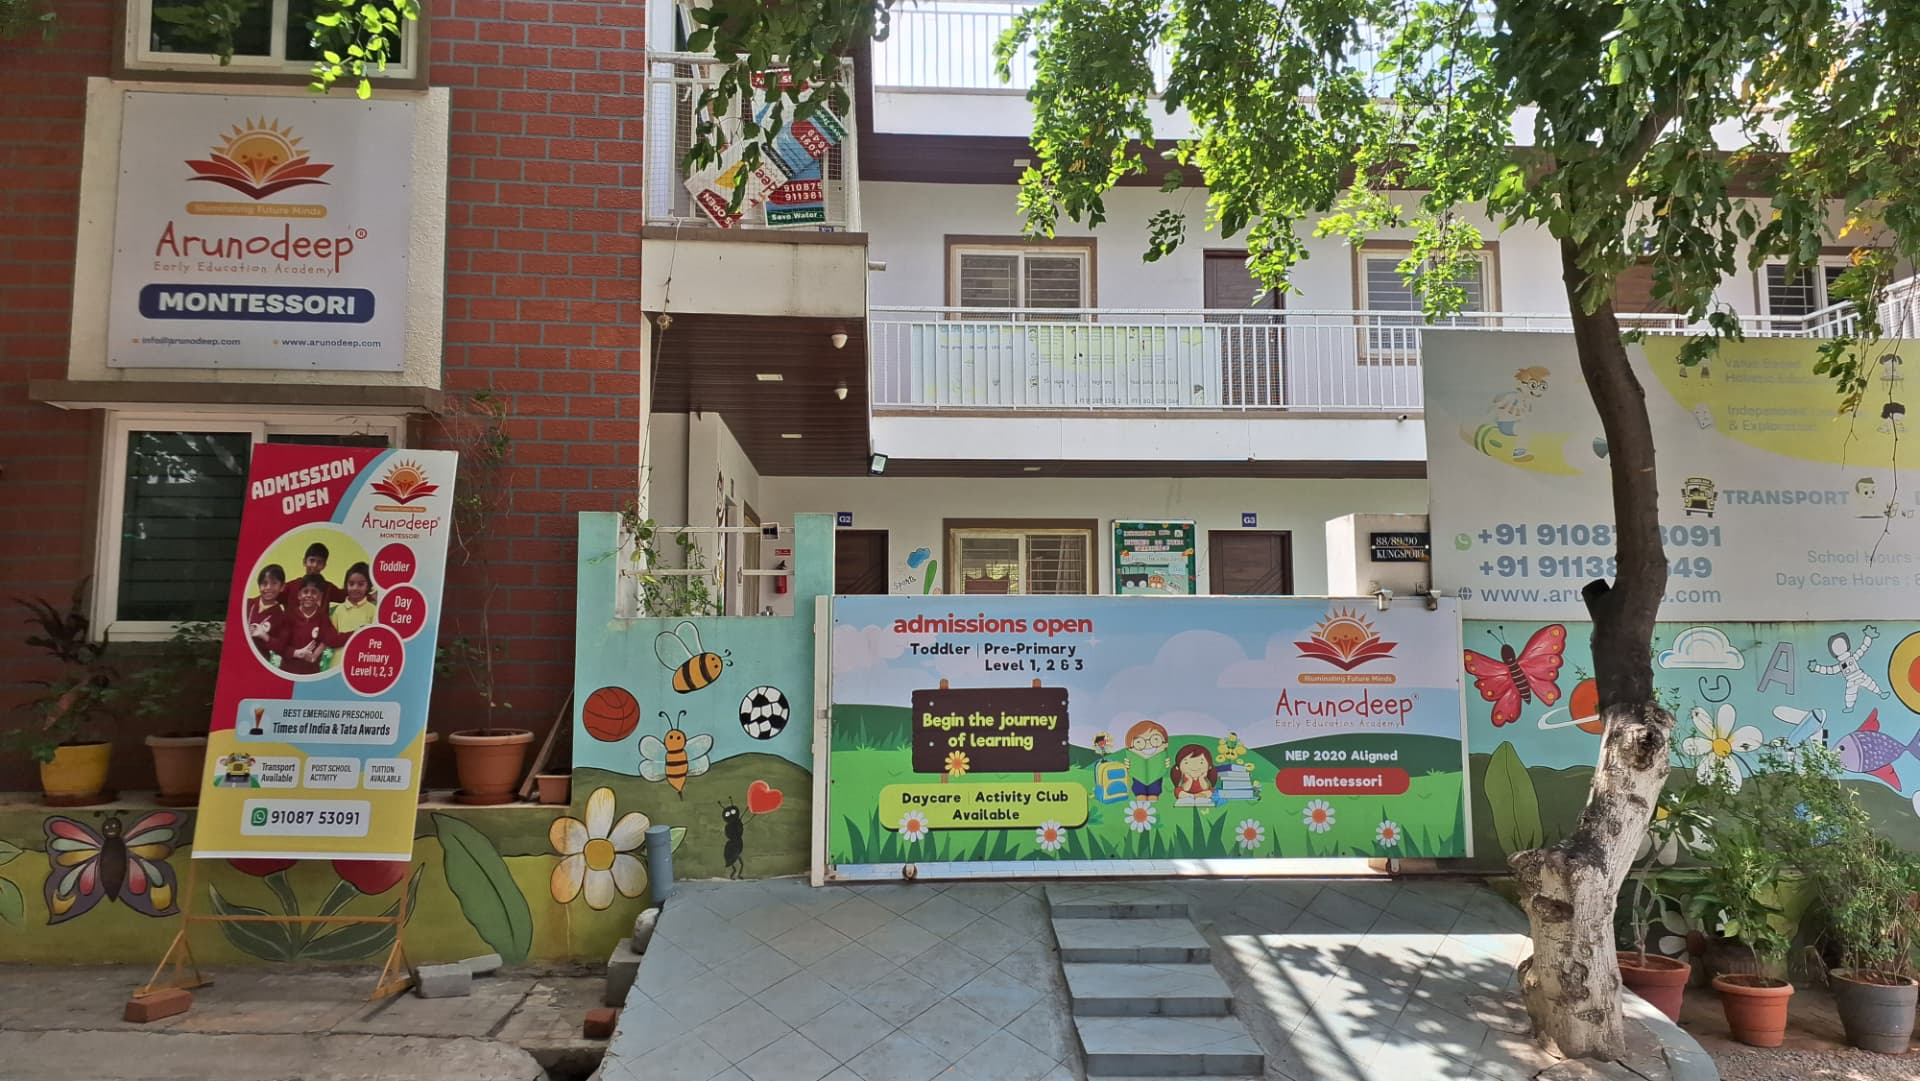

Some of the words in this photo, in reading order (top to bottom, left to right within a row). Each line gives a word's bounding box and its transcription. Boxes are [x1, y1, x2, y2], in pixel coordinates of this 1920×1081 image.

[156, 220, 354, 273] Arunodeep
[154, 261, 190, 274] Early
[197, 261, 267, 274] Education
[274, 263, 334, 277] Academy
[159, 292, 355, 315] MONTESSORI
[282, 339, 381, 348] www.arunodeep.com
[251, 457, 356, 500] ADMISSION
[282, 488, 330, 515] OPEN
[1722, 489, 1850, 505] TRANSPORT
[362, 512, 439, 536] Arunodeep
[839, 515, 852, 524] G2
[1478, 523, 1528, 545] +91
[1807, 550, 1860, 564] School
[379, 561, 410, 573] Toddler
[1479, 555, 1529, 578] +91
[1776, 572, 1805, 589] Day
[1809, 572, 1848, 586] Care
[1852, 573, 1900, 586] Hours
[394, 595, 412, 610] Day
[390, 612, 412, 625] Care
[894, 613, 1027, 633] admissions
[1033, 618, 1093, 637] open
[368, 638, 382, 650] Pre
[910, 642, 971, 655] Toddler
[984, 643, 1077, 657] Pre-Primary
[358, 651, 389, 666] Primary
[985, 659, 1024, 671] Level
[1029, 659, 1041, 672] 1,
[1046, 659, 1056, 671] 2
[1074, 659, 1084, 671] 3
[350, 666, 372, 677] Level
[282, 708, 301, 718] BEST
[302, 708, 341, 719] EMERGING
[341, 709, 384, 720] PRESCHOOL
[1276, 688, 1413, 726] Arunodeep
[922, 711, 965, 730] Begin
[968, 711, 995, 727] the
[998, 711, 1058, 730] journey
[1275, 719, 1300, 729] Early
[1306, 719, 1354, 728] Education
[1360, 719, 1401, 729] Academy
[272, 722, 298, 734] Times
[299, 722, 308, 734] of
[309, 722, 330, 735] India
[331, 723, 338, 735] &
[339, 723, 358, 735] Tata
[358, 724, 391, 736] Awards
[948, 732, 966, 747] of
[970, 732, 1034, 751] learning
[1285, 750, 1310, 761] NEP
[1313, 750, 1347, 761] 2020
[1350, 750, 1398, 763] Aligned
[262, 762, 295, 774] Transport
[311, 764, 328, 772] POST
[328, 764, 353, 773] SCHOOL
[371, 765, 395, 774] TUITION
[261, 773, 293, 783] Available
[310, 774, 338, 782] ACTIVITY
[370, 775, 401, 783] AVAILABLE
[1303, 774, 1383, 788] Montessori
[902, 792, 961, 806] Daycare
[975, 791, 1031, 804] Activity
[1036, 791, 1068, 803] Club
[271, 810, 314, 825] 91087
[319, 811, 360, 825] 53091
[952, 809, 1020, 821] Available
